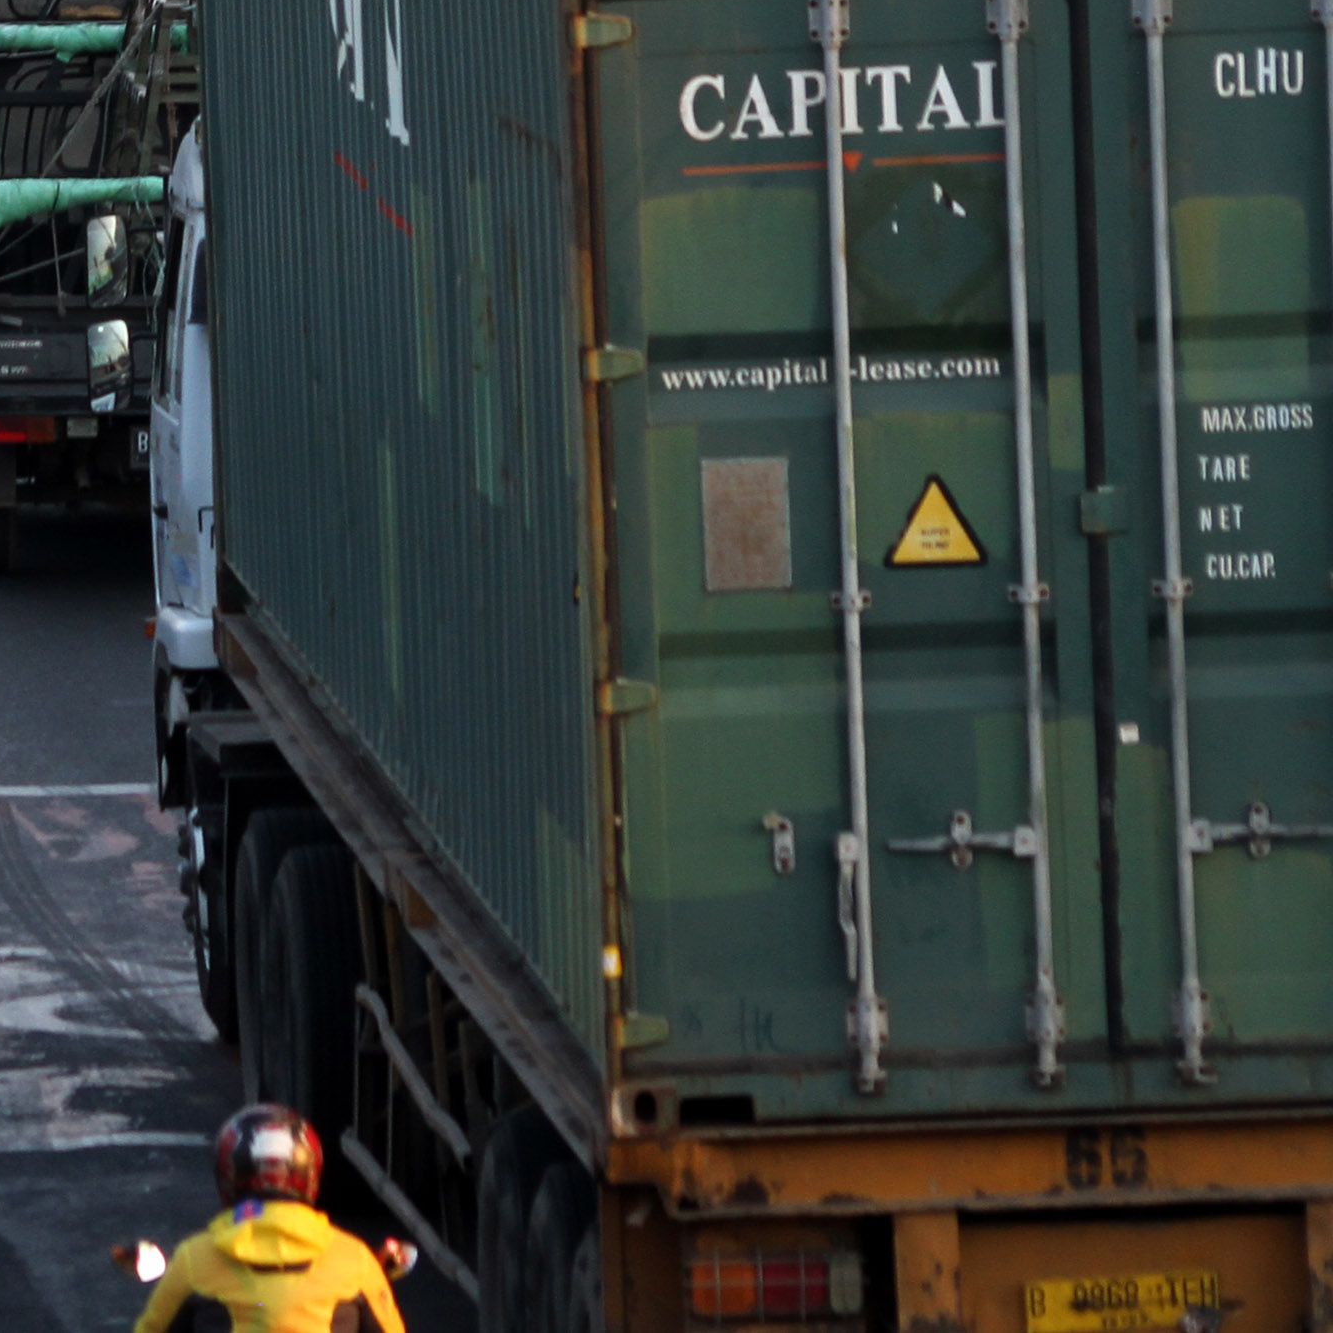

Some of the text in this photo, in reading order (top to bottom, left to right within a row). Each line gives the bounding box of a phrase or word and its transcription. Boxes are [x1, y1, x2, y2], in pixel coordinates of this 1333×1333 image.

[1214, 46, 1304, 98] CLHU
[677, 60, 1009, 142] CAPITAL
[1200, 403, 1314, 435] MAX.GROSS
[137, 431, 149, 453] B
[1197, 453, 1252, 483] TARE
[1198, 503, 1244, 532] NET
[1205, 551, 1277, 580] CU.CAP.
[1028, 1285, 1046, 1318] B
